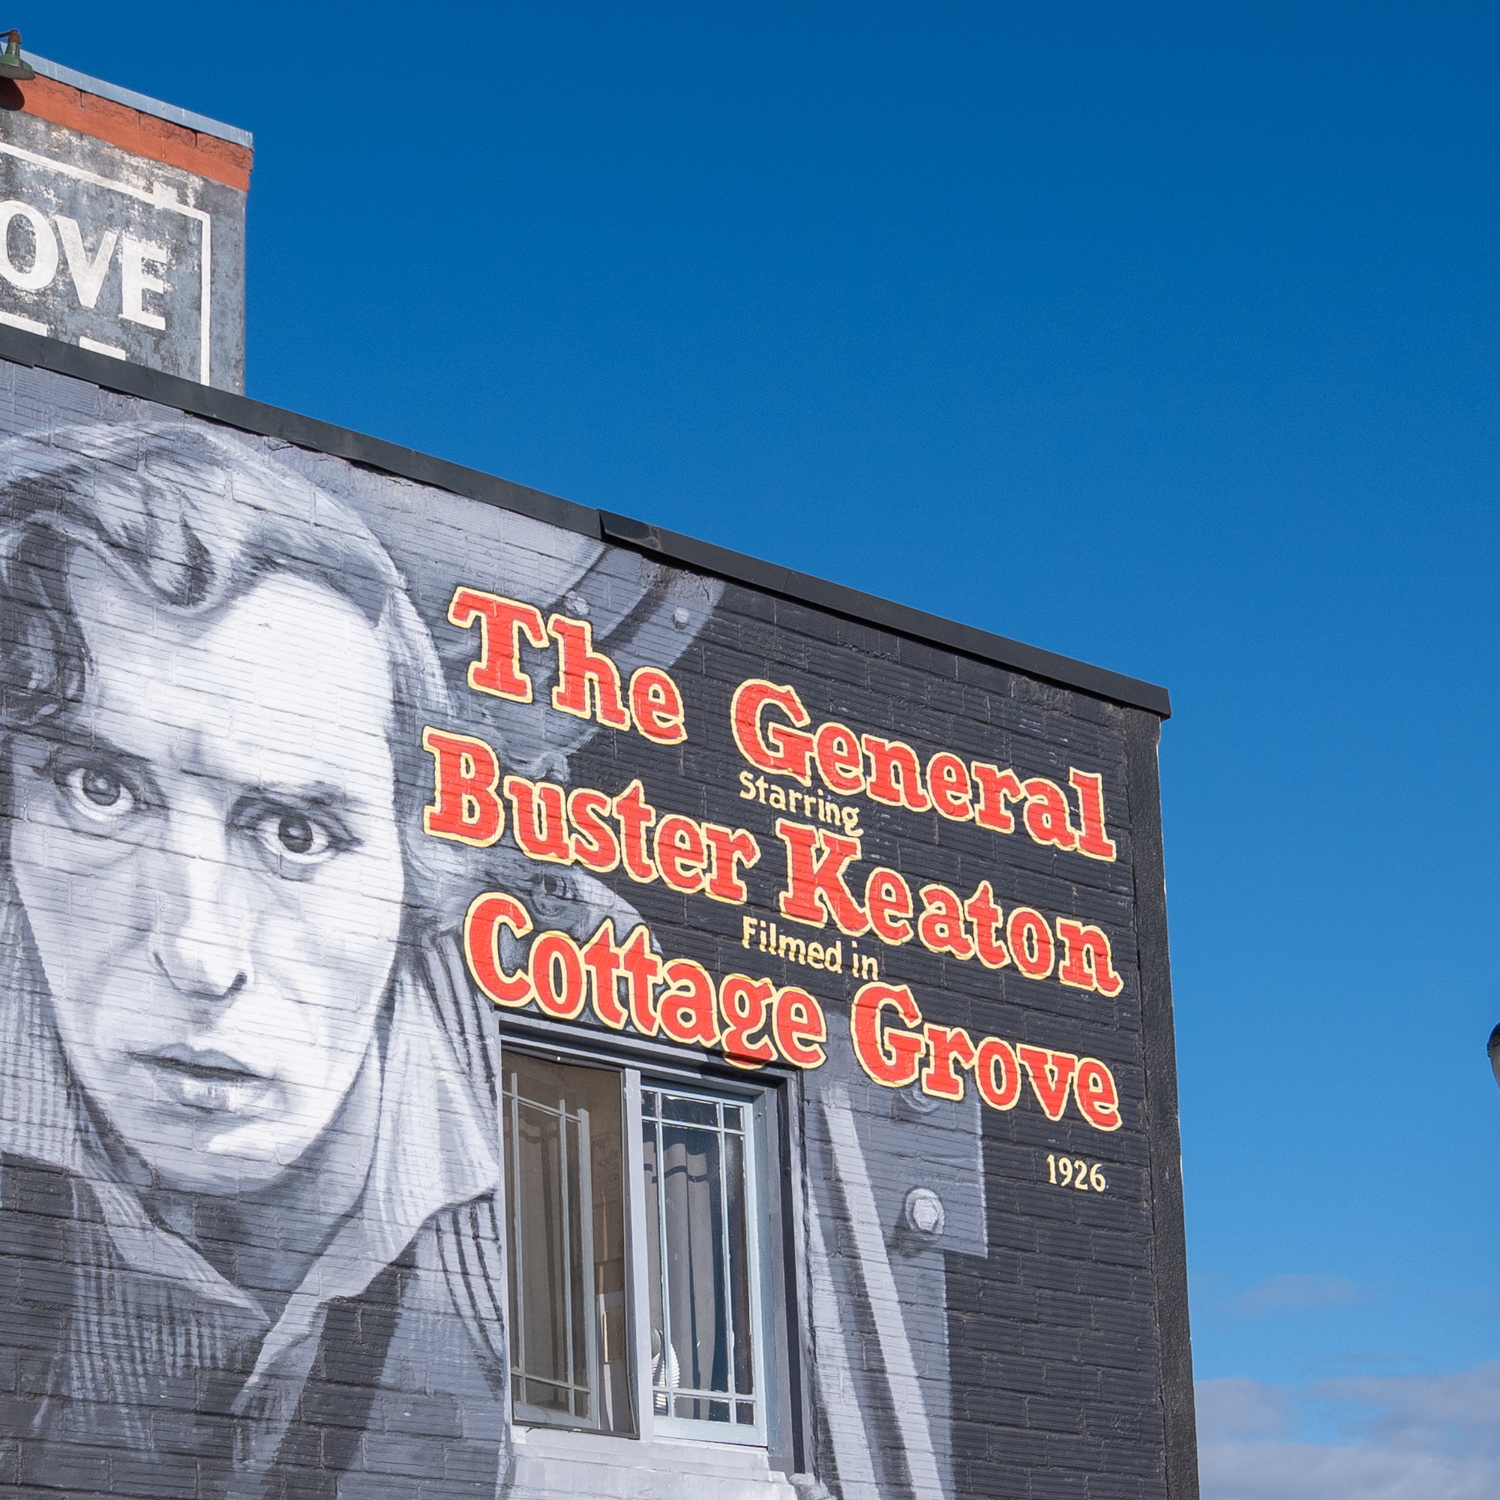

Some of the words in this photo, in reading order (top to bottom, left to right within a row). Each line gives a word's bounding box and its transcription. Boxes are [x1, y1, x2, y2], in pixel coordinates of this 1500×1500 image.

[447, 584, 688, 746] The
[730, 678, 1117, 862] General
[421, 725, 760, 906] Buster
[774, 820, 1124, 997] Keaton
[739, 772, 862, 836] Starring
[463, 890, 827, 1070] Cottage
[851, 982, 1122, 1131] Grove
[742, 914, 842, 976] Filmed
[851, 941, 878, 981] in
[1047, 1154, 1106, 1193] 1926
